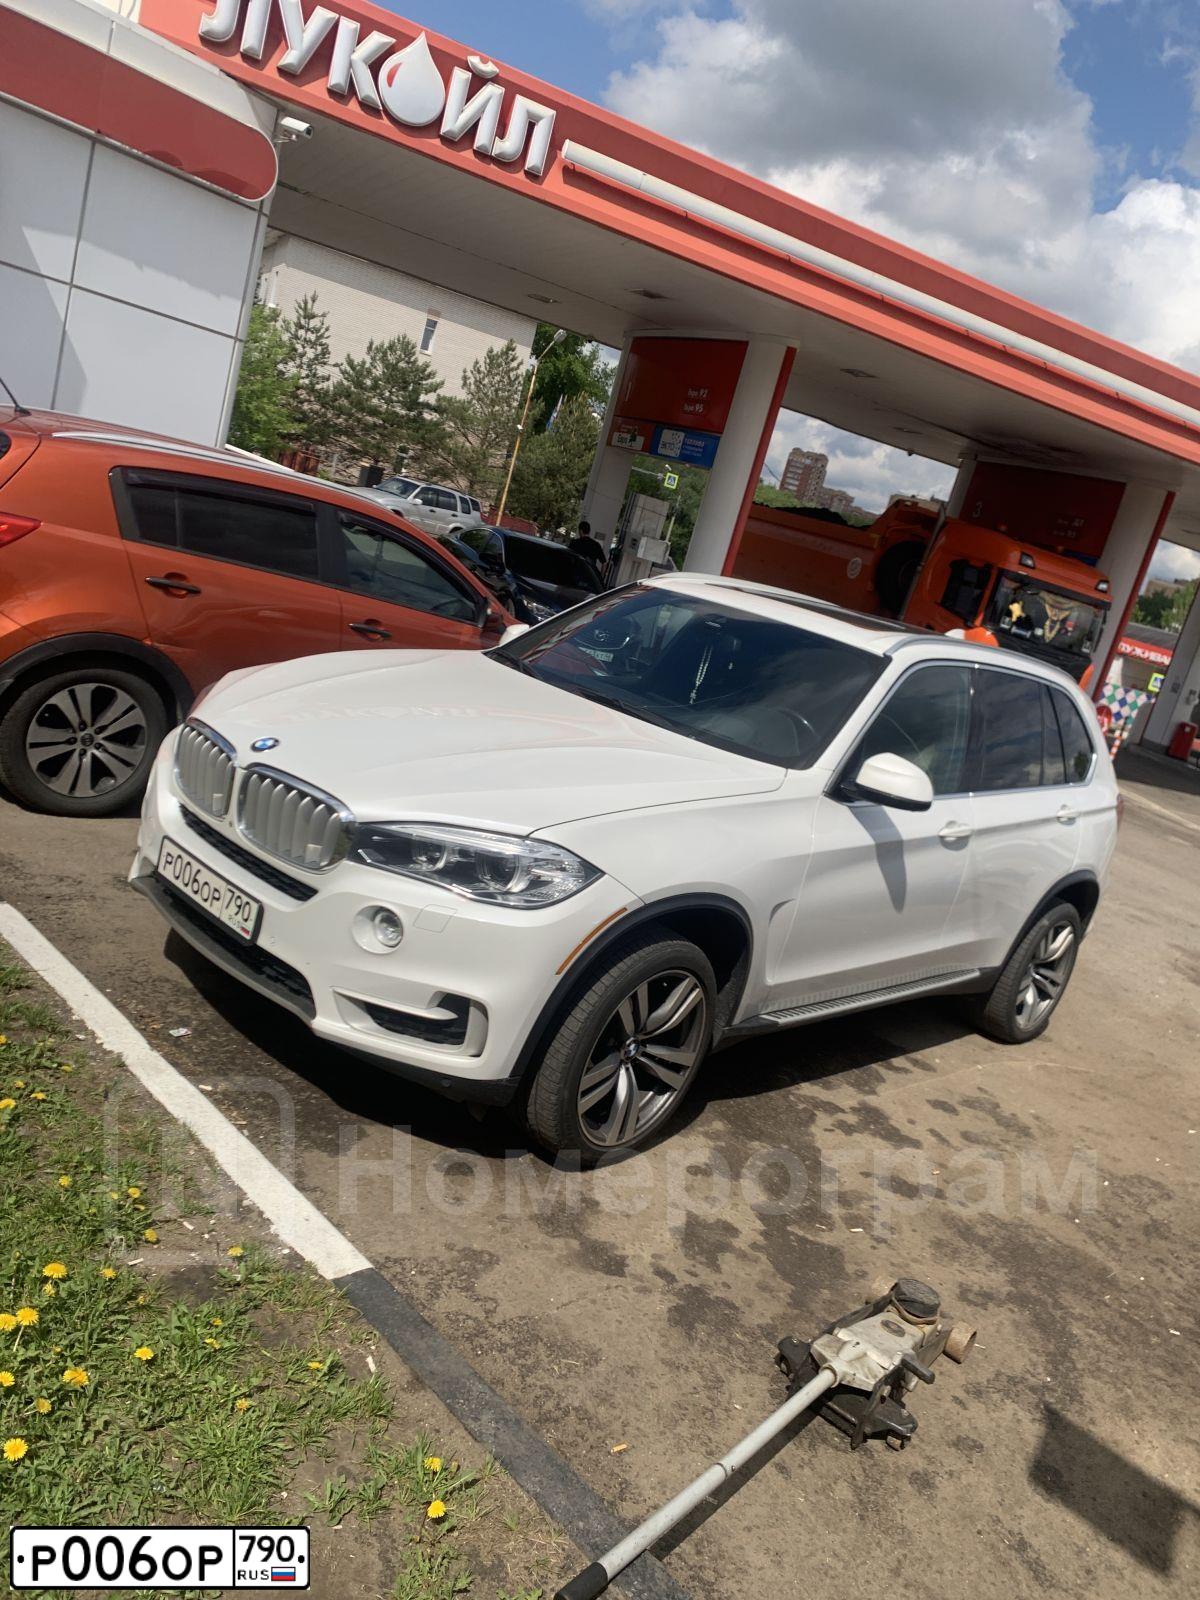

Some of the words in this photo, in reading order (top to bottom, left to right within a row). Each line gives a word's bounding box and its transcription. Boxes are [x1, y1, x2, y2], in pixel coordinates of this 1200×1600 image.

[198, 0, 556, 176] ЛУКОЙЛ
[163, 852, 220, 907] Р006ОР
[226, 888, 251, 922] 790
